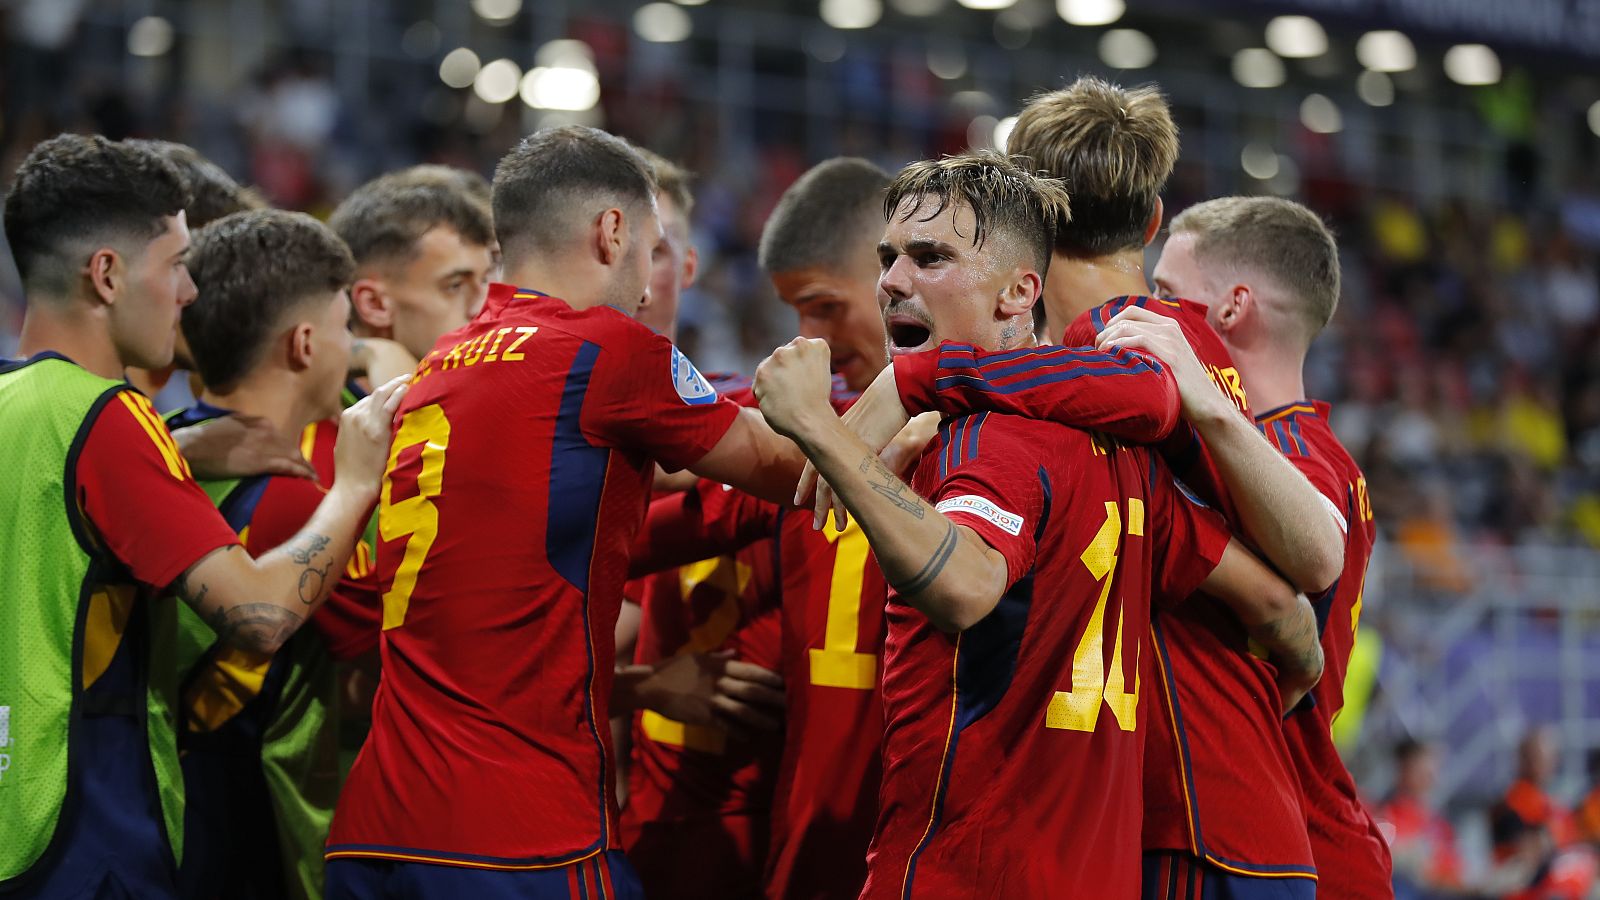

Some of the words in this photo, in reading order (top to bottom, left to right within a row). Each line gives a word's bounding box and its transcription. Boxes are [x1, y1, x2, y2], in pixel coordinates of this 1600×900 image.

[439, 326, 539, 370] RUIZ
[379, 404, 451, 631] 9
[1046, 498, 1145, 733] 10
